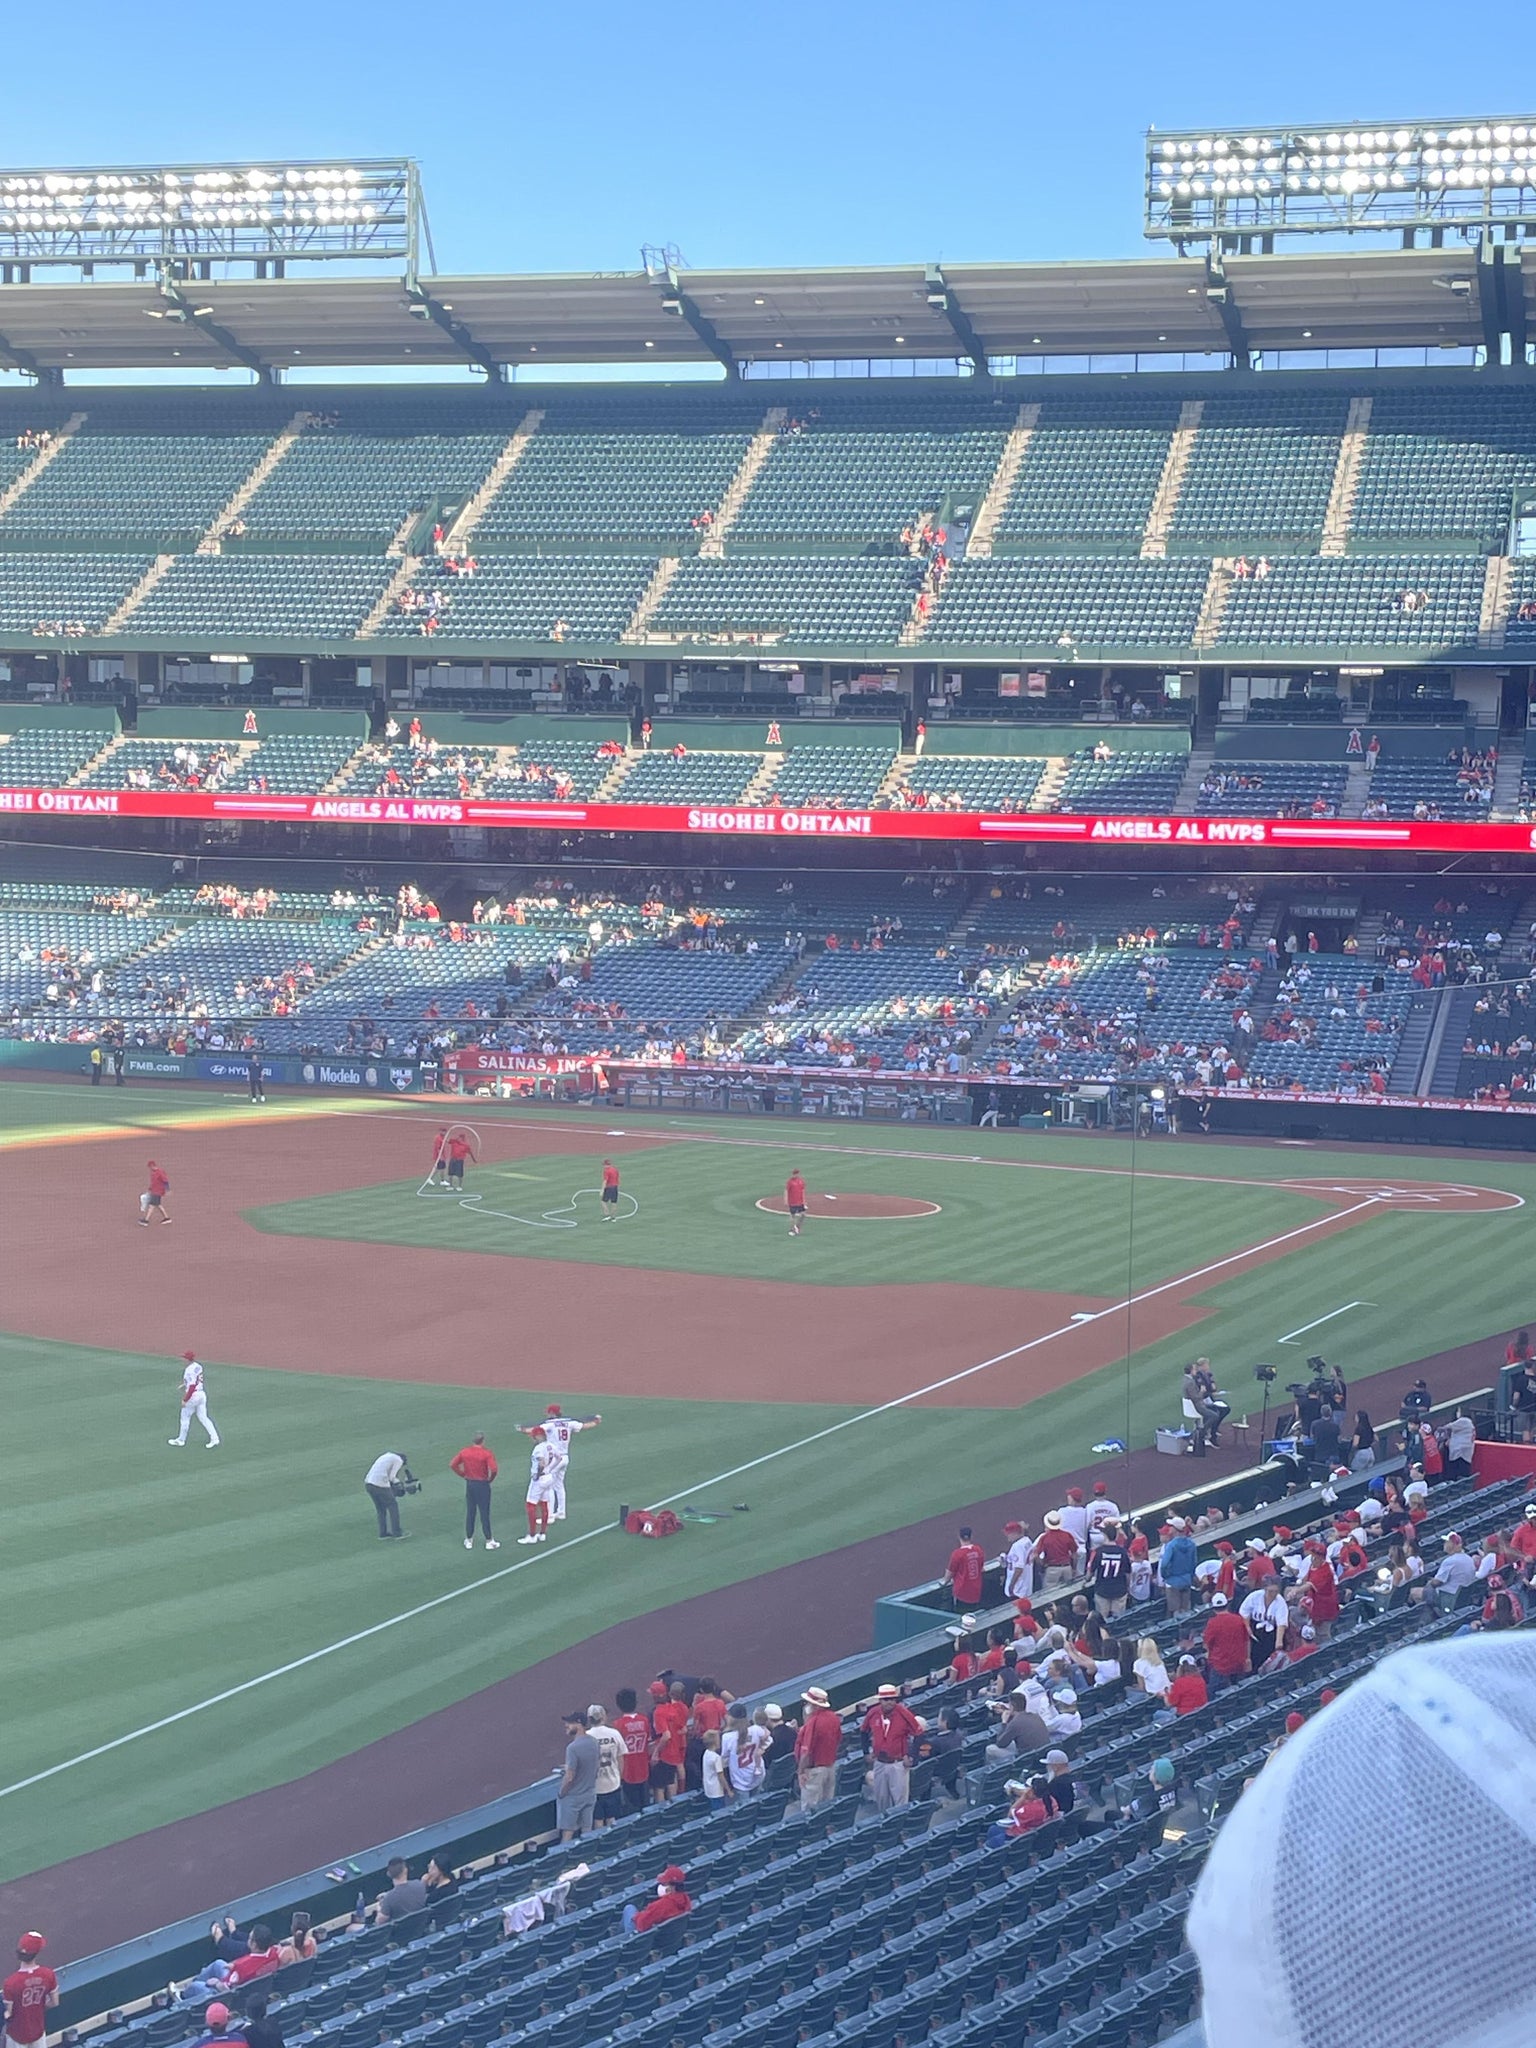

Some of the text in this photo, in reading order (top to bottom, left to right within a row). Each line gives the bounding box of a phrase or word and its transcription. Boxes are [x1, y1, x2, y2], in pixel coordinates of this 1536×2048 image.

[38, 792, 118, 812] OHTANI
[311, 802, 462, 820] ANGELS AL MVPS
[688, 809, 871, 833] SHOHEI OHTANI
[1091, 820, 1265, 841] ANGELS AL MVPS
[130, 1061, 180, 1073] FMB.com
[228, 1066, 272, 1076] HYUAI
[478, 1055, 551, 1074] SALINAS,
[557, 1059, 591, 1073] INC.
[320, 1067, 360, 1084] Modelo
[1101, 1560, 1120, 1578] 77
[1136, 1572, 1150, 1586] 27
[626, 1732, 648, 1753] 27
[22, 1985, 46, 2007] 27
